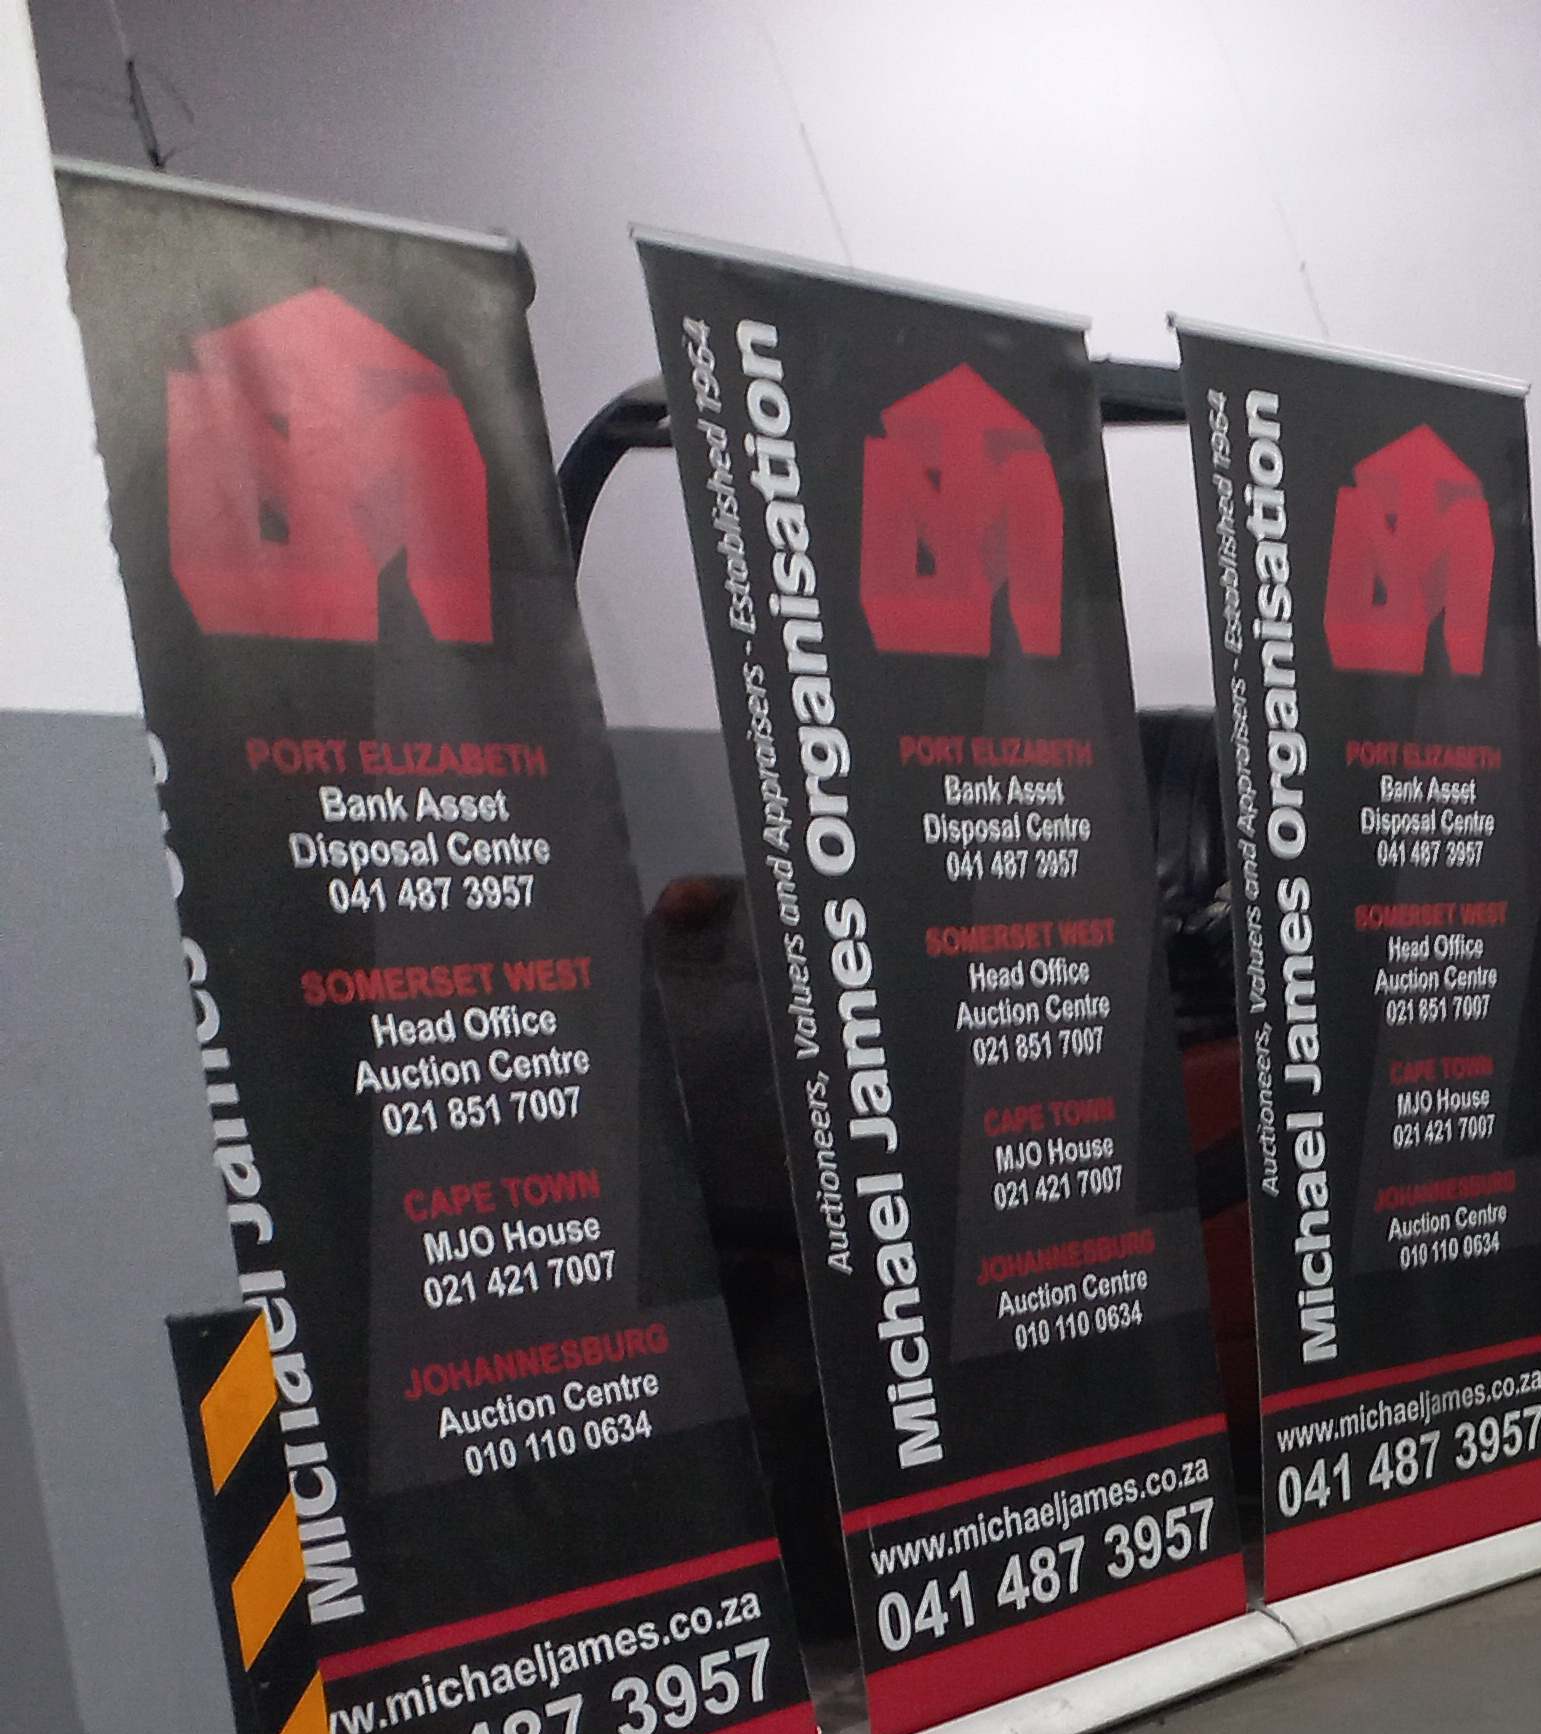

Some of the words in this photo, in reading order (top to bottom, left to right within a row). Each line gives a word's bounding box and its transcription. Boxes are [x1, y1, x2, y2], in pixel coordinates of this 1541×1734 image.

[683, 315, 722, 414] 1964
[697, 418, 756, 635] Established
[736, 318, 857, 877] Organisation
[1245, 388, 1307, 860] Organisation
[245, 738, 345, 775] PORT
[359, 741, 549, 776] ELIZABETH
[743, 663, 793, 850] Appraisers
[318, 787, 408, 823] Bank
[416, 788, 509, 822] Asset
[945, 774, 1001, 805] Bank
[1007, 776, 1064, 805] Asset
[922, 812, 1020, 848] Disposal
[1027, 812, 1091, 842] Centre
[1360, 807, 1435, 839] Disposal
[1441, 809, 1495, 836] Centre
[288, 831, 438, 873] Disposal
[447, 832, 551, 864] Centre
[947, 852, 983, 881] 041
[991, 850, 1028, 879] 487
[328, 878, 385, 913] 041
[399, 877, 450, 910] 487
[464, 875, 534, 909] 3957
[774, 854, 800, 929] and
[1388, 936, 1429, 962] Head
[1434, 934, 1483, 960] Office
[300, 963, 494, 1007] SOMERSET
[504, 956, 591, 992] WEST
[787, 933, 820, 1060] Valuers
[969, 961, 1024, 992] Head
[1030, 958, 1090, 987] Office
[1277, 876, 1322, 1095] James
[1374, 967, 1439, 995] Auction
[1444, 965, 1497, 990] Centre
[371, 1010, 455, 1047] Head
[464, 1004, 557, 1040] Office
[824, 897, 900, 1153] James
[956, 998, 1039, 1031] Auction
[1046, 994, 1110, 1023] Centre
[1386, 1000, 1414, 1025] 021
[1419, 998, 1446, 1023] 851
[1453, 994, 1490, 1020] 7007
[355, 1057, 480, 1095] Auction
[489, 1045, 590, 1080] Centre
[972, 1037, 1008, 1066] 021
[1016, 1032, 1051, 1061] 851
[1058, 1027, 1104, 1056] 7007
[382, 1102, 438, 1136] 021
[448, 1096, 501, 1131] 851
[509, 1087, 581, 1123] 7007
[1397, 1090, 1432, 1117] MJO
[1437, 1088, 1489, 1112] House
[996, 1140, 1042, 1173] MJO
[1048, 1134, 1114, 1166] House
[1393, 1123, 1420, 1149] 021
[1425, 1119, 1452, 1145] 421
[1458, 1114, 1495, 1141] 7007
[404, 1181, 495, 1222] CAPE
[506, 1169, 600, 1209] TOWN
[806, 1072, 854, 1275] Auctioneers,
[993, 1178, 1029, 1211] 021
[1035, 1172, 1071, 1203] 421
[1078, 1164, 1123, 1198] 7007
[423, 1226, 494, 1266] MJO
[502, 1216, 601, 1253] House
[1285, 1110, 1338, 1365] Michael
[1387, 1213, 1450, 1241] Auction
[1455, 1203, 1507, 1229] Centre
[1400, 1245, 1427, 1270] 010
[1431, 1239, 1459, 1262] 110
[1463, 1231, 1500, 1256] 0634
[423, 1273, 474, 1310] 021
[487, 1261, 538, 1298] 421
[547, 1250, 616, 1289] 7007
[996, 1284, 1077, 1319] Auction
[1082, 1268, 1148, 1299] Centre
[855, 1172, 944, 1470] Michael
[1015, 1319, 1049, 1351] 010
[1055, 1311, 1090, 1342] 110
[1095, 1300, 1143, 1333] 0634
[405, 1323, 669, 1400] JOHANNESBURG
[439, 1396, 555, 1438] Auction
[563, 1370, 659, 1413] Centre
[464, 1438, 517, 1477] 010
[524, 1425, 576, 1464] 110
[584, 1410, 652, 1449] 0634
[1278, 1454, 1352, 1519] 041
[1369, 1430, 1440, 1491] 487
[870, 1458, 1209, 1576] www.michaeljames.co.za
[878, 1569, 974, 1653] 041
[996, 1536, 1085, 1612] 487
[1104, 1498, 1215, 1579] 3957
